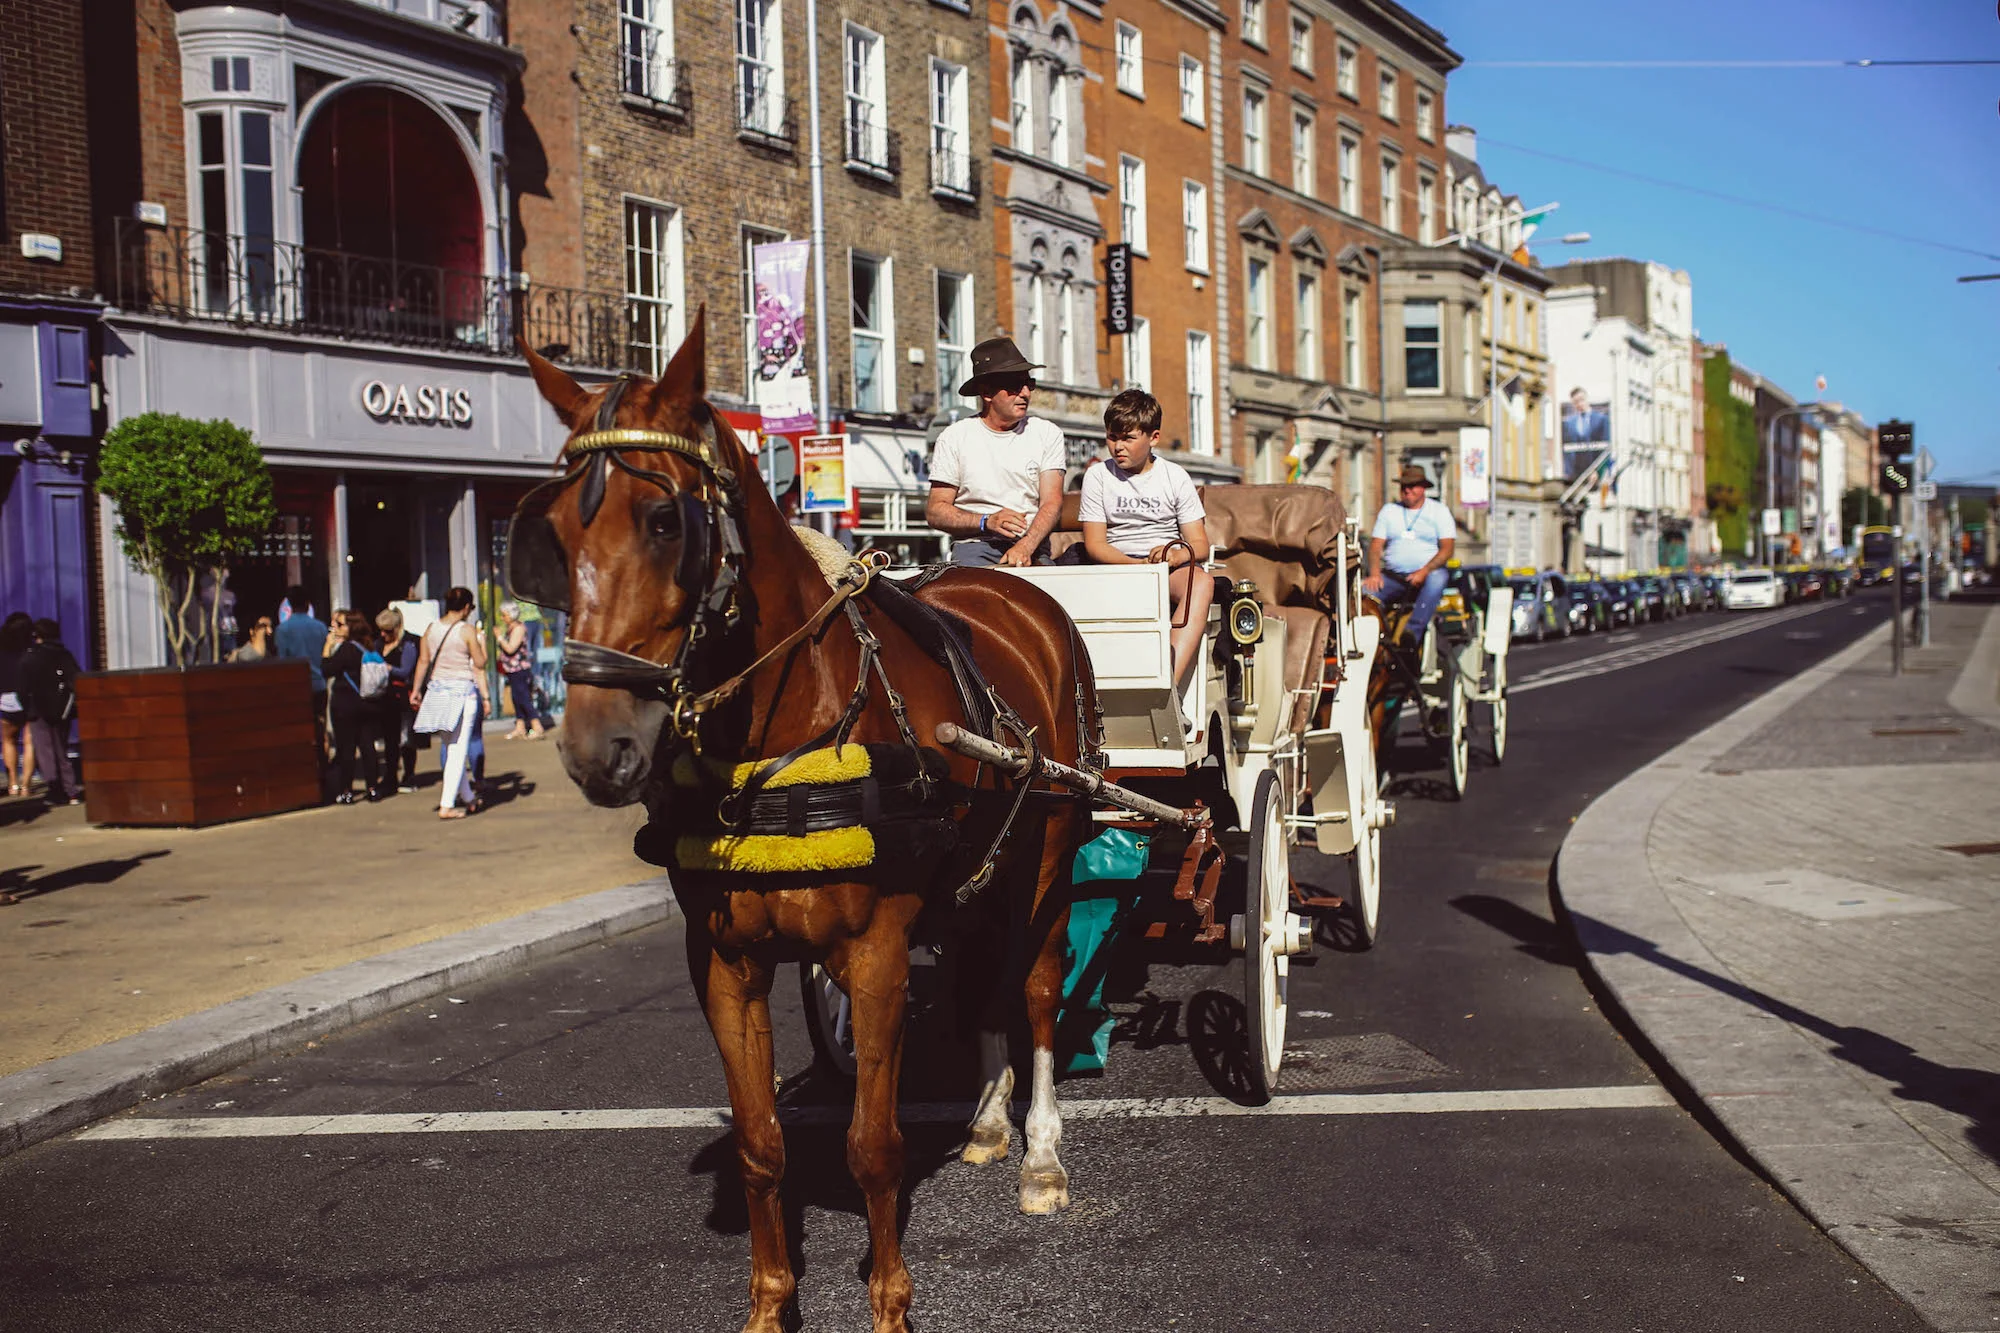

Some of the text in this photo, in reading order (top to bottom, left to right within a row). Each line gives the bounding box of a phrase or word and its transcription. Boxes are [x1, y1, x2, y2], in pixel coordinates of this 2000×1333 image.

[1110, 247, 1127, 331] TOPSHOP
[362, 380, 472, 424] OASIS
[1116, 496, 1161, 508] BOSS
